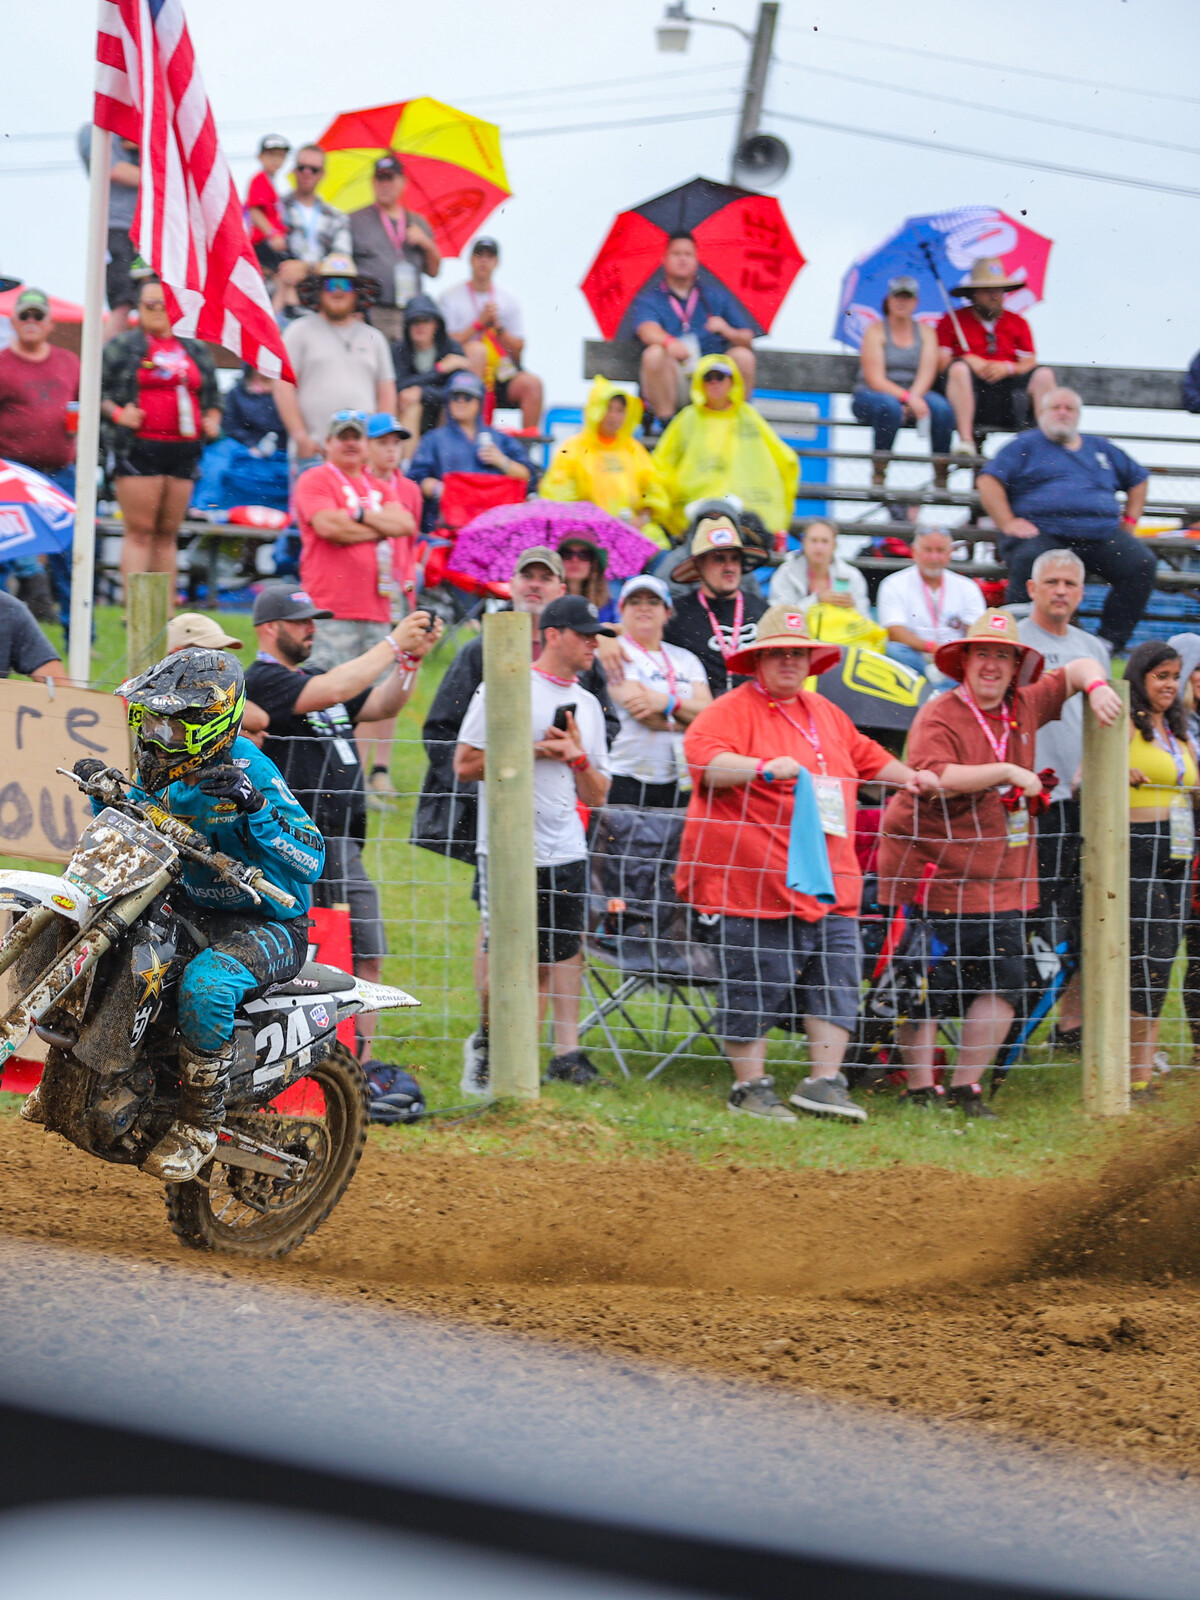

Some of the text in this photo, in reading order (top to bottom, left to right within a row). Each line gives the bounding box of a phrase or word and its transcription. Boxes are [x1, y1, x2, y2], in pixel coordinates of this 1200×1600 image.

[270, 836, 319, 872] ROCKSTAR
[292, 978, 320, 989] GUTS
[253, 1006, 315, 1086] 24
